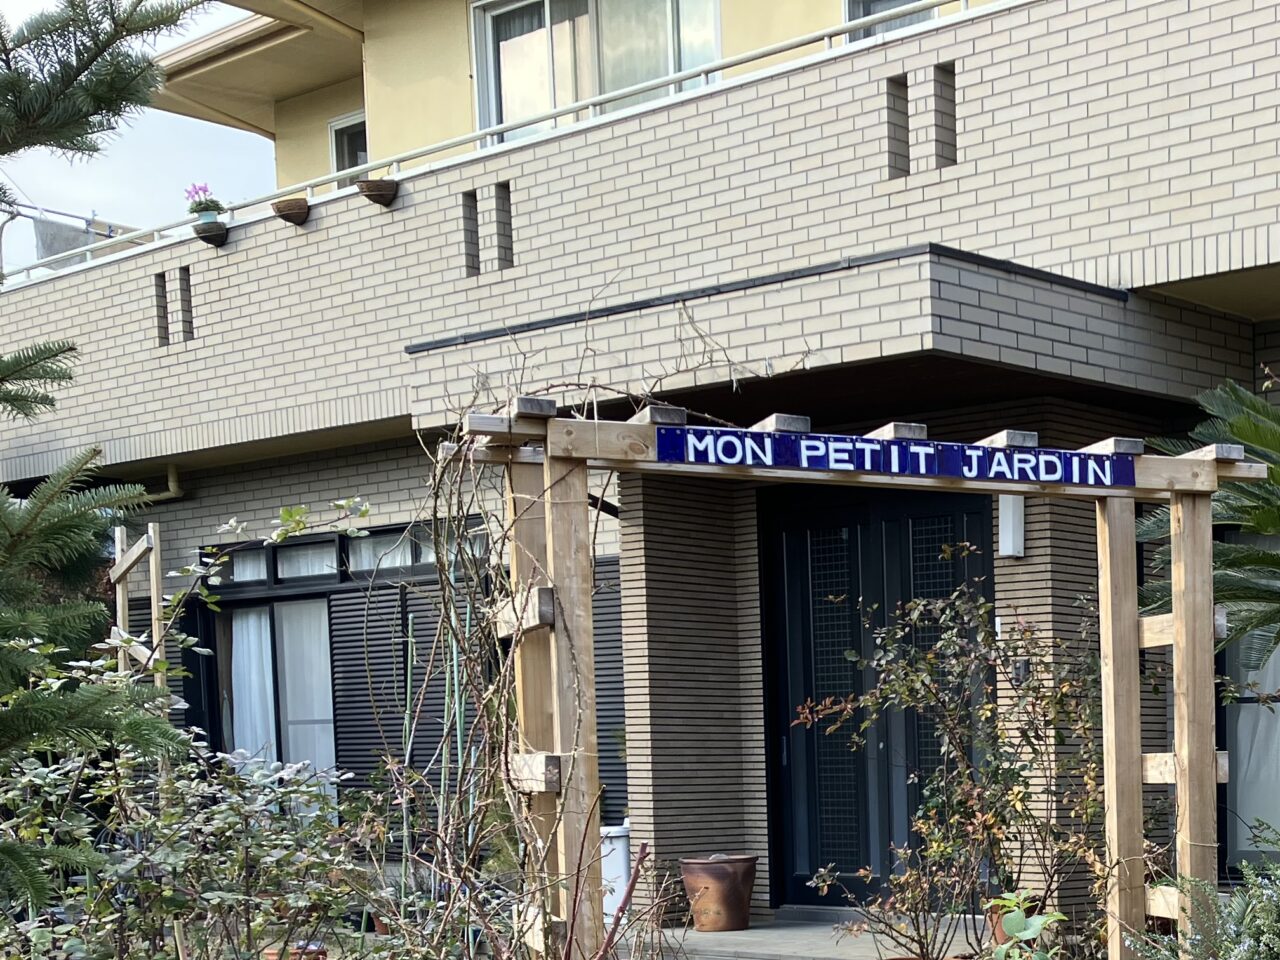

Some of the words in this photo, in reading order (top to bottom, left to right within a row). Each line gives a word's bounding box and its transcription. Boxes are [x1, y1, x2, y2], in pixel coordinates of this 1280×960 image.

[687, 434, 773, 466] MON
[800, 439, 935, 475] PETIT
[962, 449, 1112, 486] JARDIN
